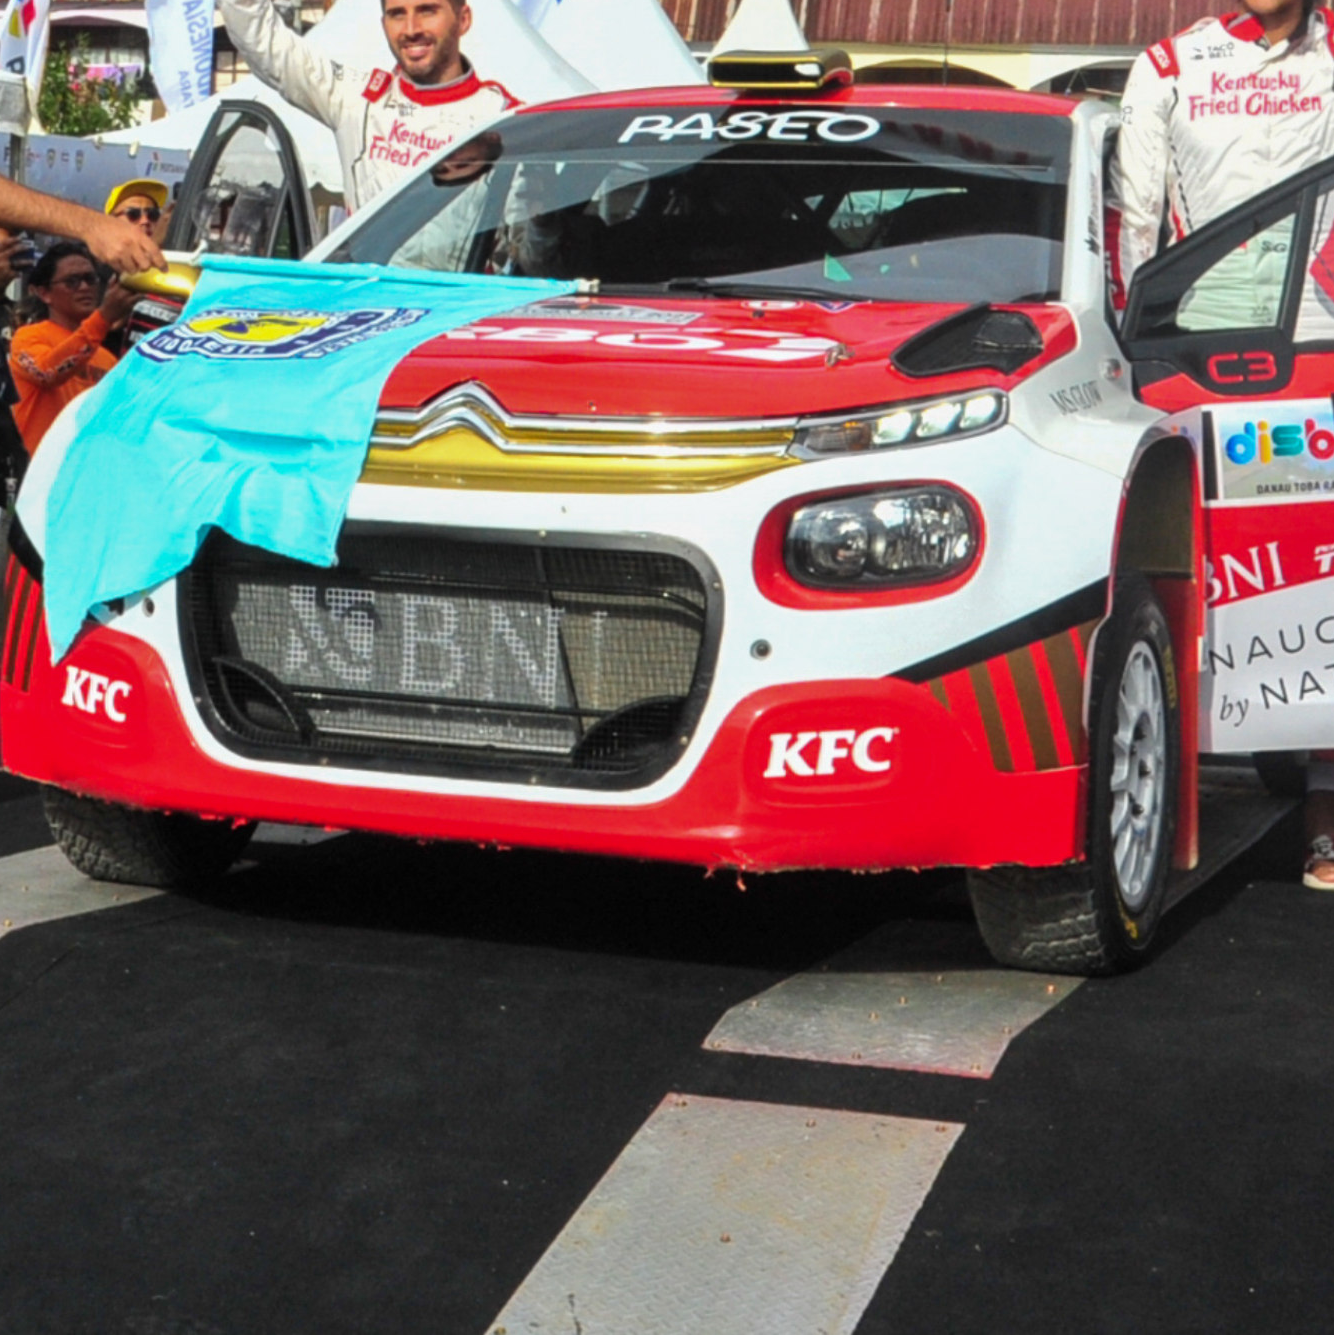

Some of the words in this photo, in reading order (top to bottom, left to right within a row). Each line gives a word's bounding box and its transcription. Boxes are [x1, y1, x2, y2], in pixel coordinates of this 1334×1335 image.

[1211, 70, 1300, 95] Kentucky
[1188, 94, 1240, 121] Fried
[1245, 92, 1323, 116] Chicken
[618, 110, 881, 143] PASEO
[369, 135, 410, 167] Fried
[1207, 351, 1277, 382] C3
[1256, 482, 1292, 495] DANAU
[1293, 481, 1321, 493] TOBA
[401, 594, 609, 710] BNI
[61, 665, 133, 723] KFC
[1218, 695, 1250, 728] by
[763, 726, 896, 779] KFC
